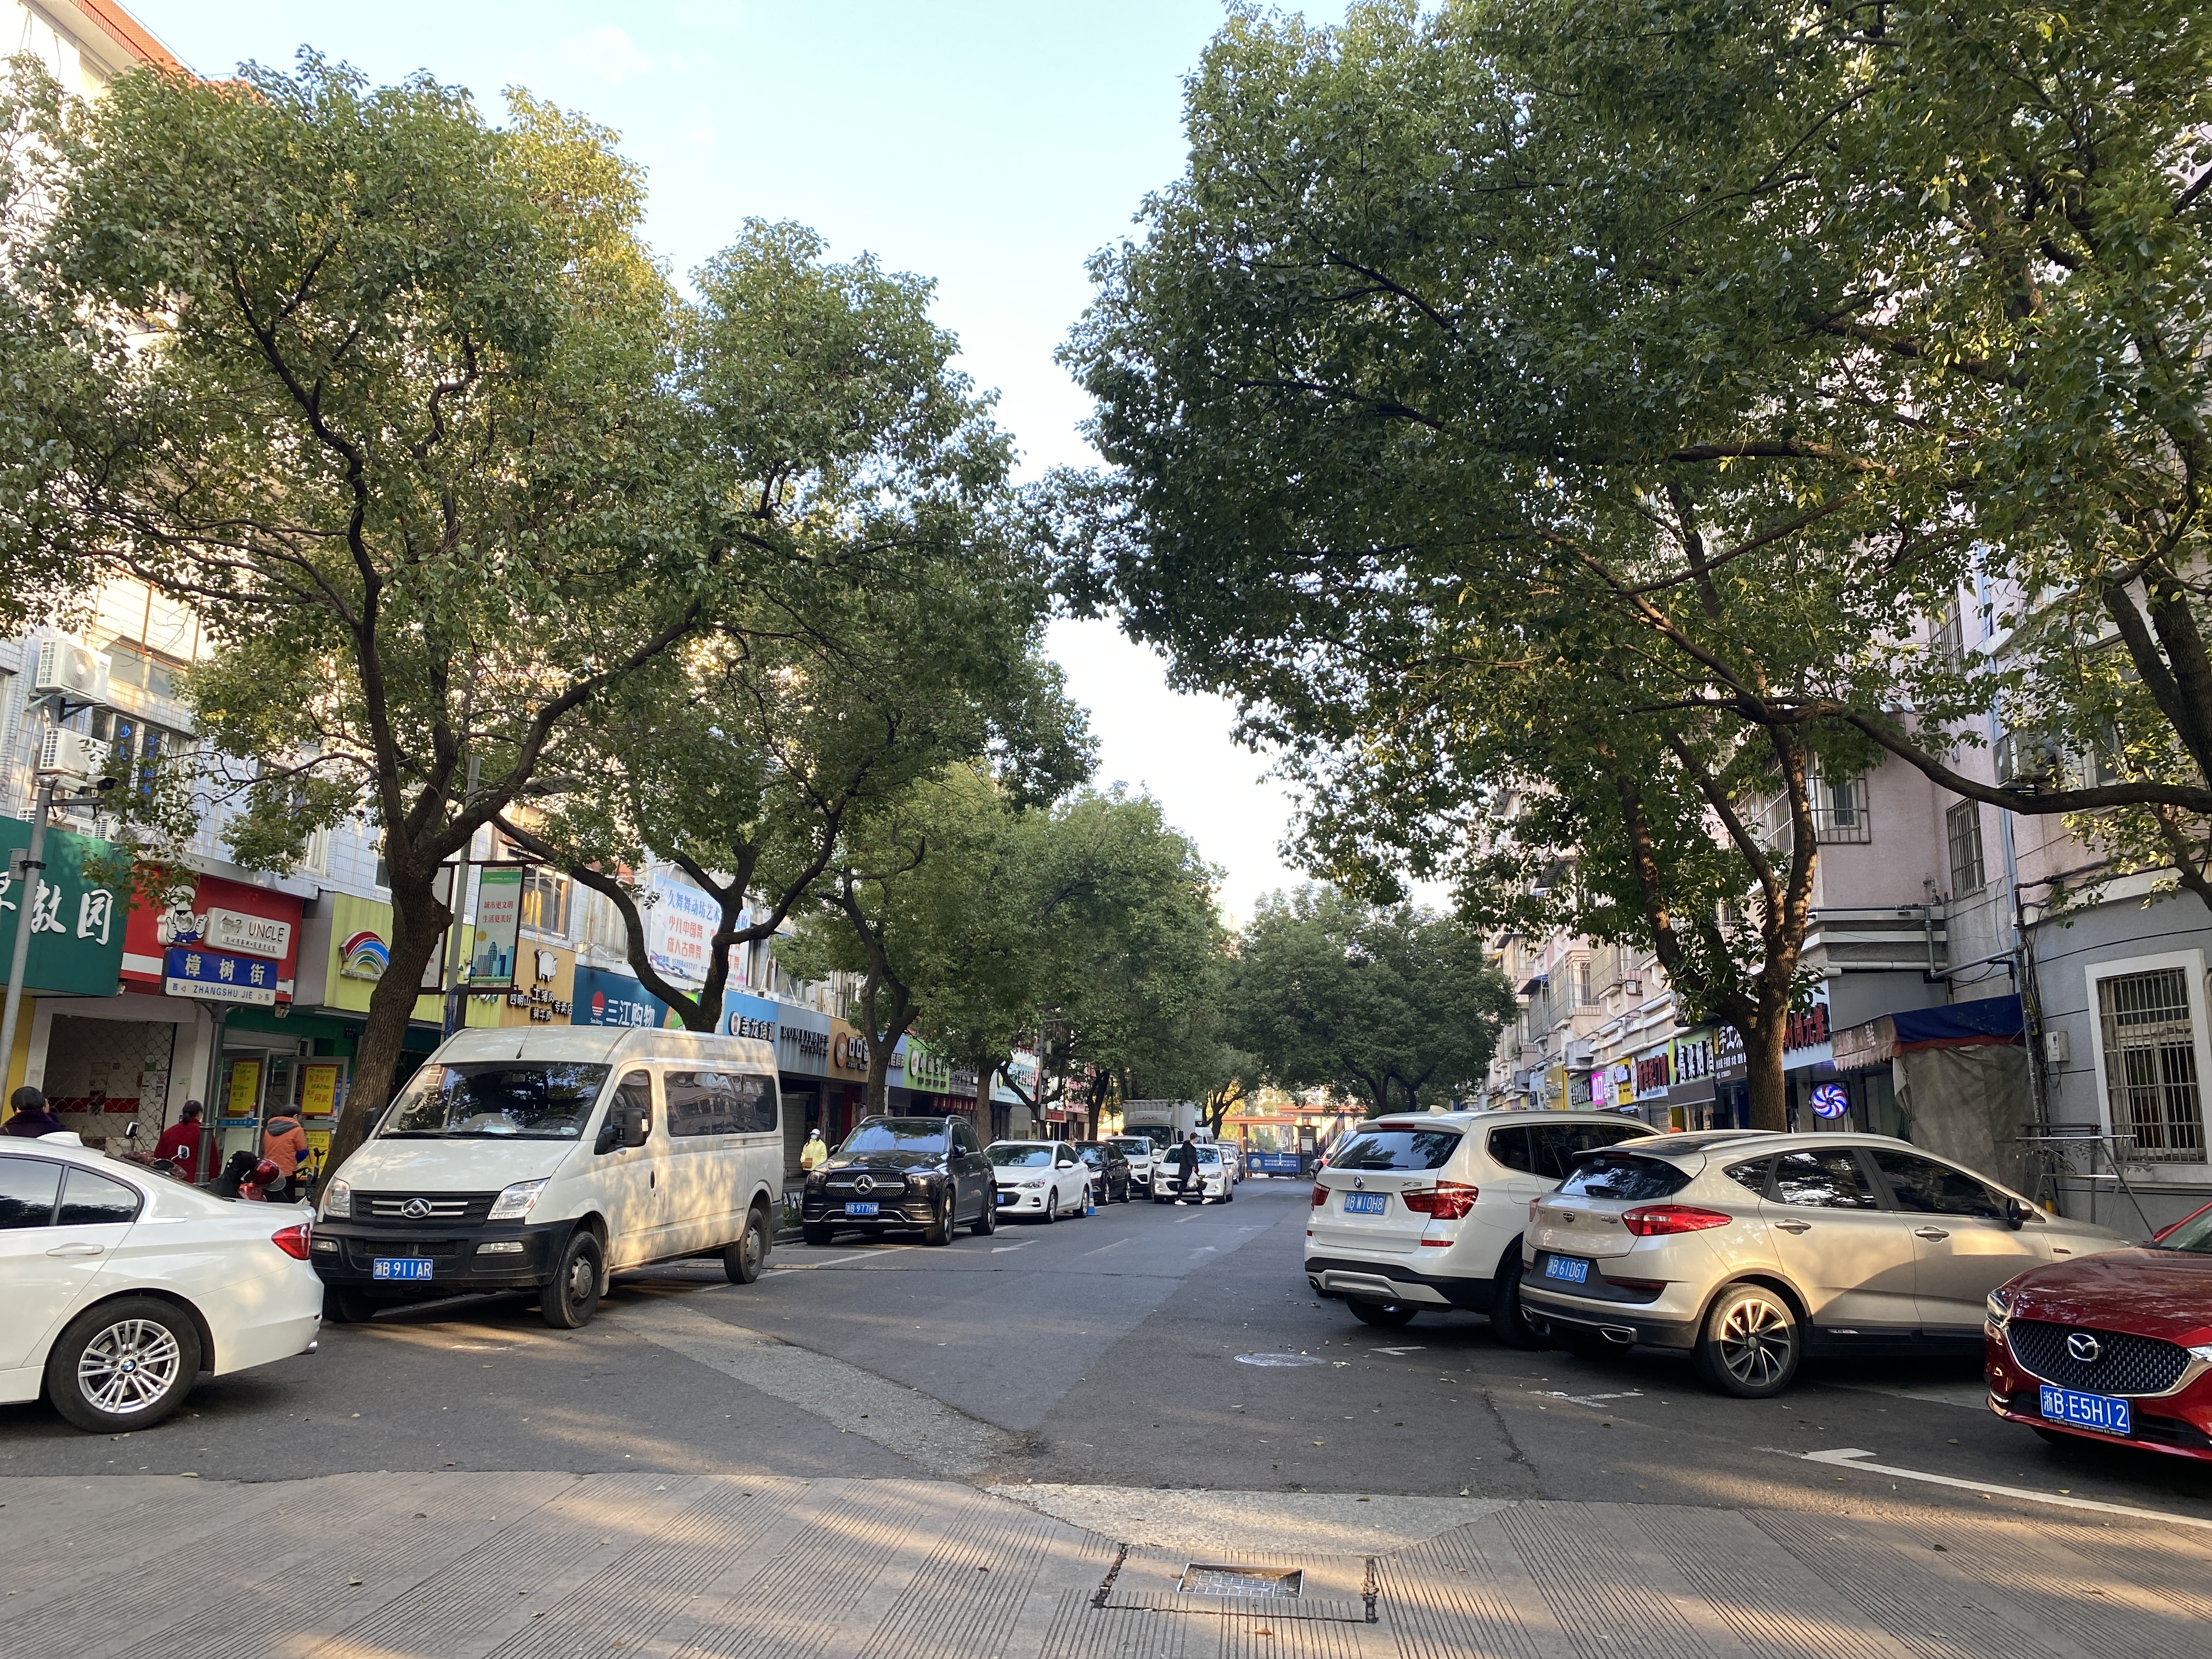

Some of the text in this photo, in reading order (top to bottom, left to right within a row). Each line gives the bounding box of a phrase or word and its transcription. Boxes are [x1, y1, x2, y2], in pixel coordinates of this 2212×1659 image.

[483, 901, 514, 909] 城市更文明
[483, 915, 512, 923] 生活更美好
[669, 915, 703, 939] 少儿中国舞
[249, 922, 285, 943] UNCLE
[667, 937, 702, 961] 成人古典舞
[185, 953, 265, 985] 樟树街
[193, 985, 253, 999] ZHANGSHU JIE
[532, 984, 555, 1003] 土猪肉
[510, 994, 531, 1007] 四明山
[554, 1001, 574, 1015] 专卖店
[533, 1007, 552, 1021] 黄牛肉
[606, 998, 656, 1028] 三江购物
